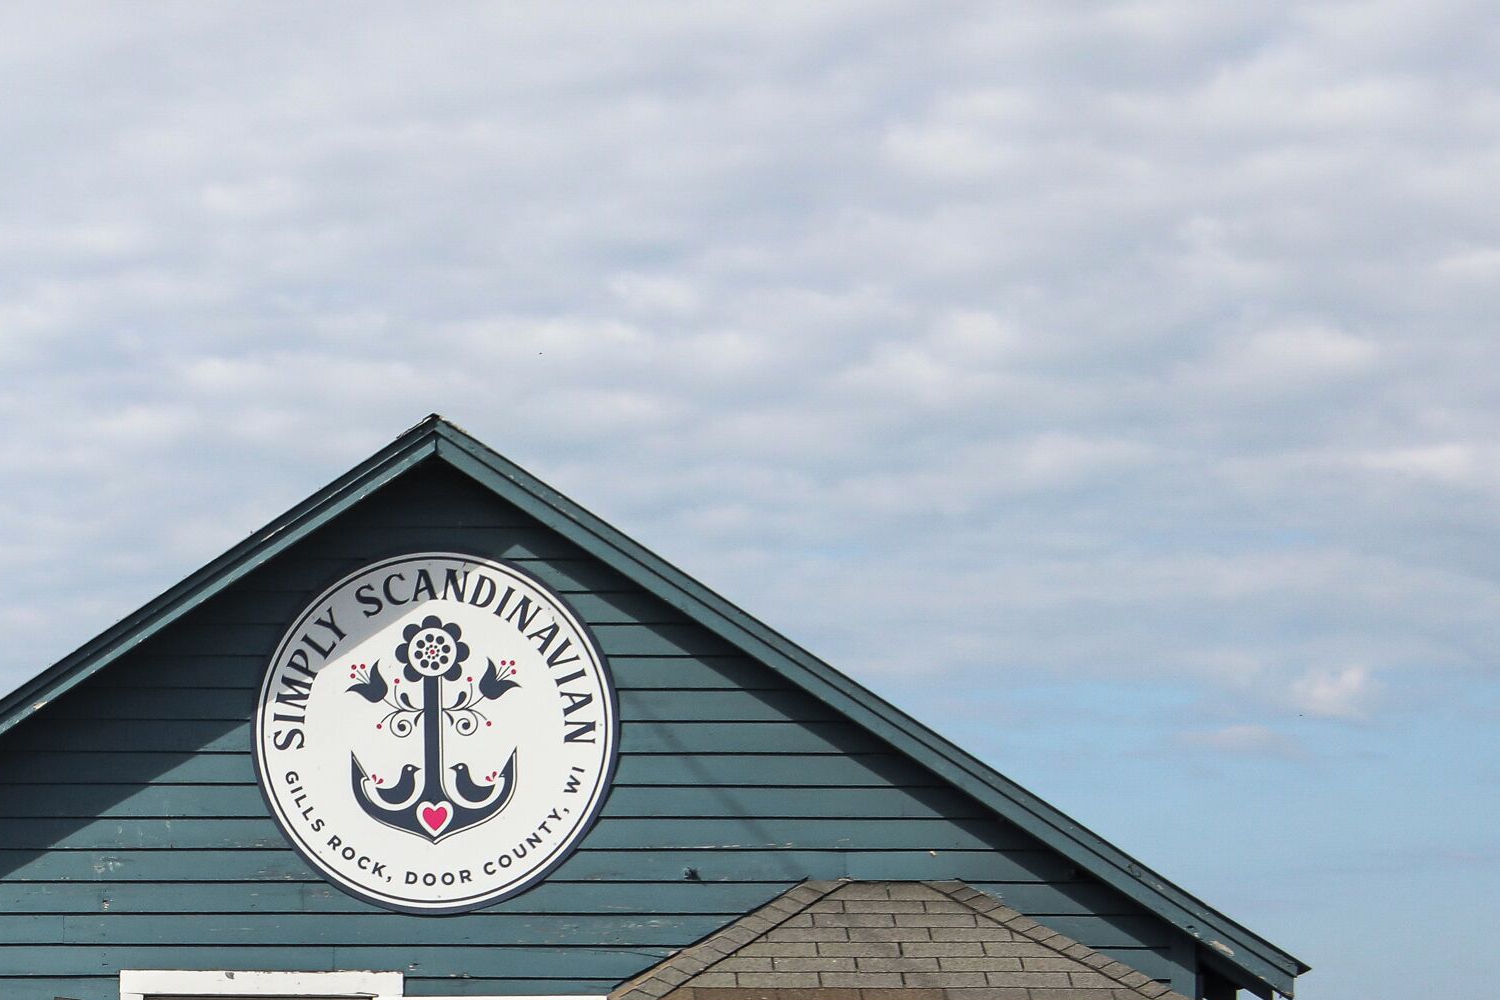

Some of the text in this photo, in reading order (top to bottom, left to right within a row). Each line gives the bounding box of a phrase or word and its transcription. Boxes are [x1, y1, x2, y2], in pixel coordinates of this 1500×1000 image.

[273, 568, 596, 751] SIMPLY SCANDINAVIAN
[285, 766, 586, 886] GILLS ROCK, DOOR COUNTY, WI
